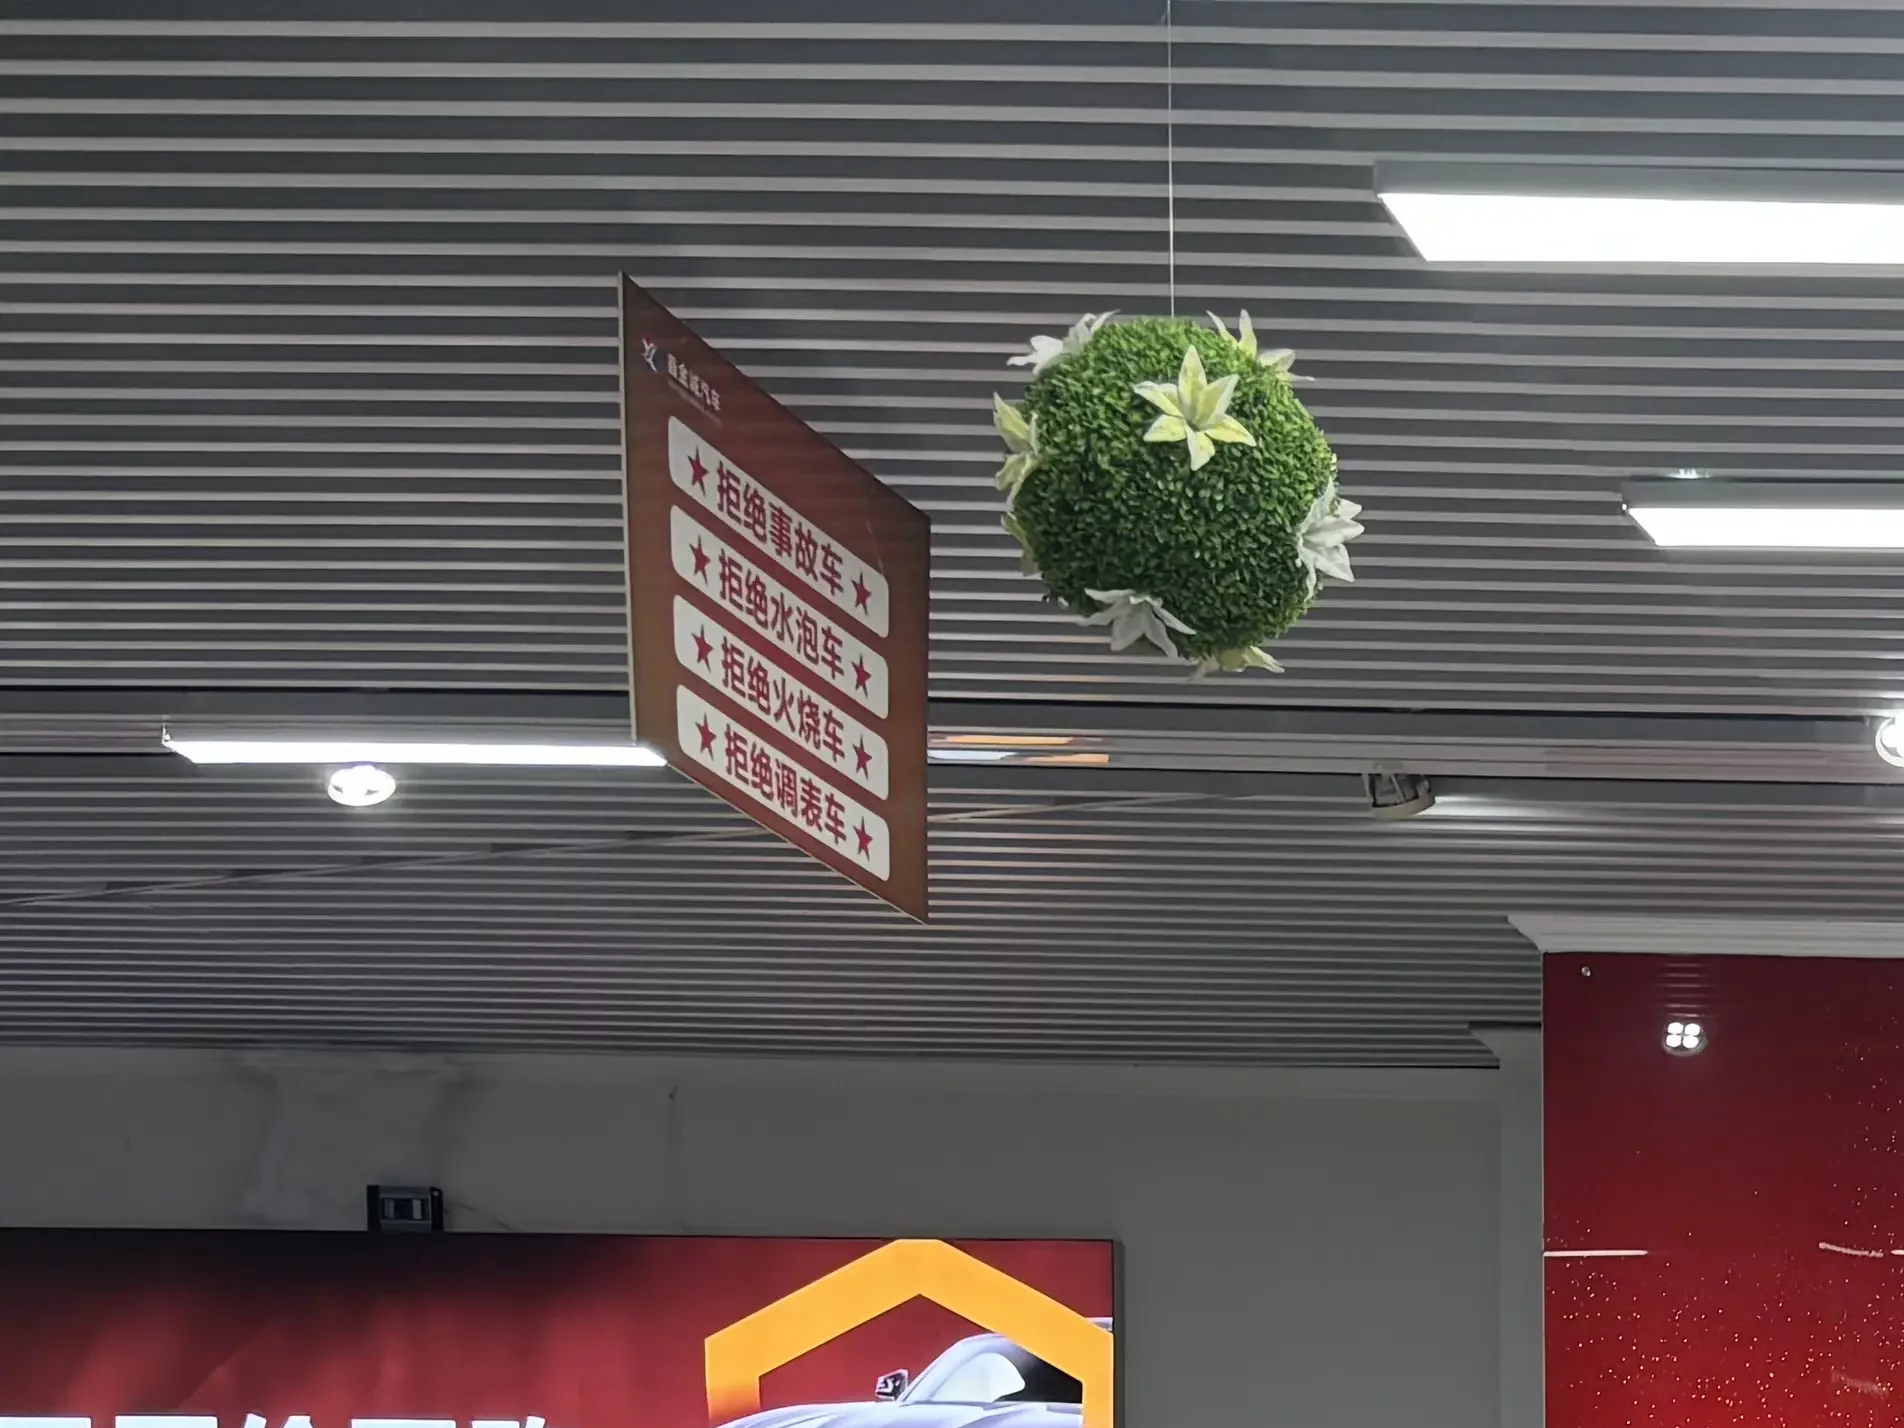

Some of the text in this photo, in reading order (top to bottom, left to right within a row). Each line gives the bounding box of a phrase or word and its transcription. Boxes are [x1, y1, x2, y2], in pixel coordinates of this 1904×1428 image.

[716, 466, 844, 597] 拒绝事故车
[718, 555, 844, 680] 拒绝水泡车
[720, 642, 845, 764] 拒绝火烧车
[724, 723, 847, 846] 拒绝调表车
